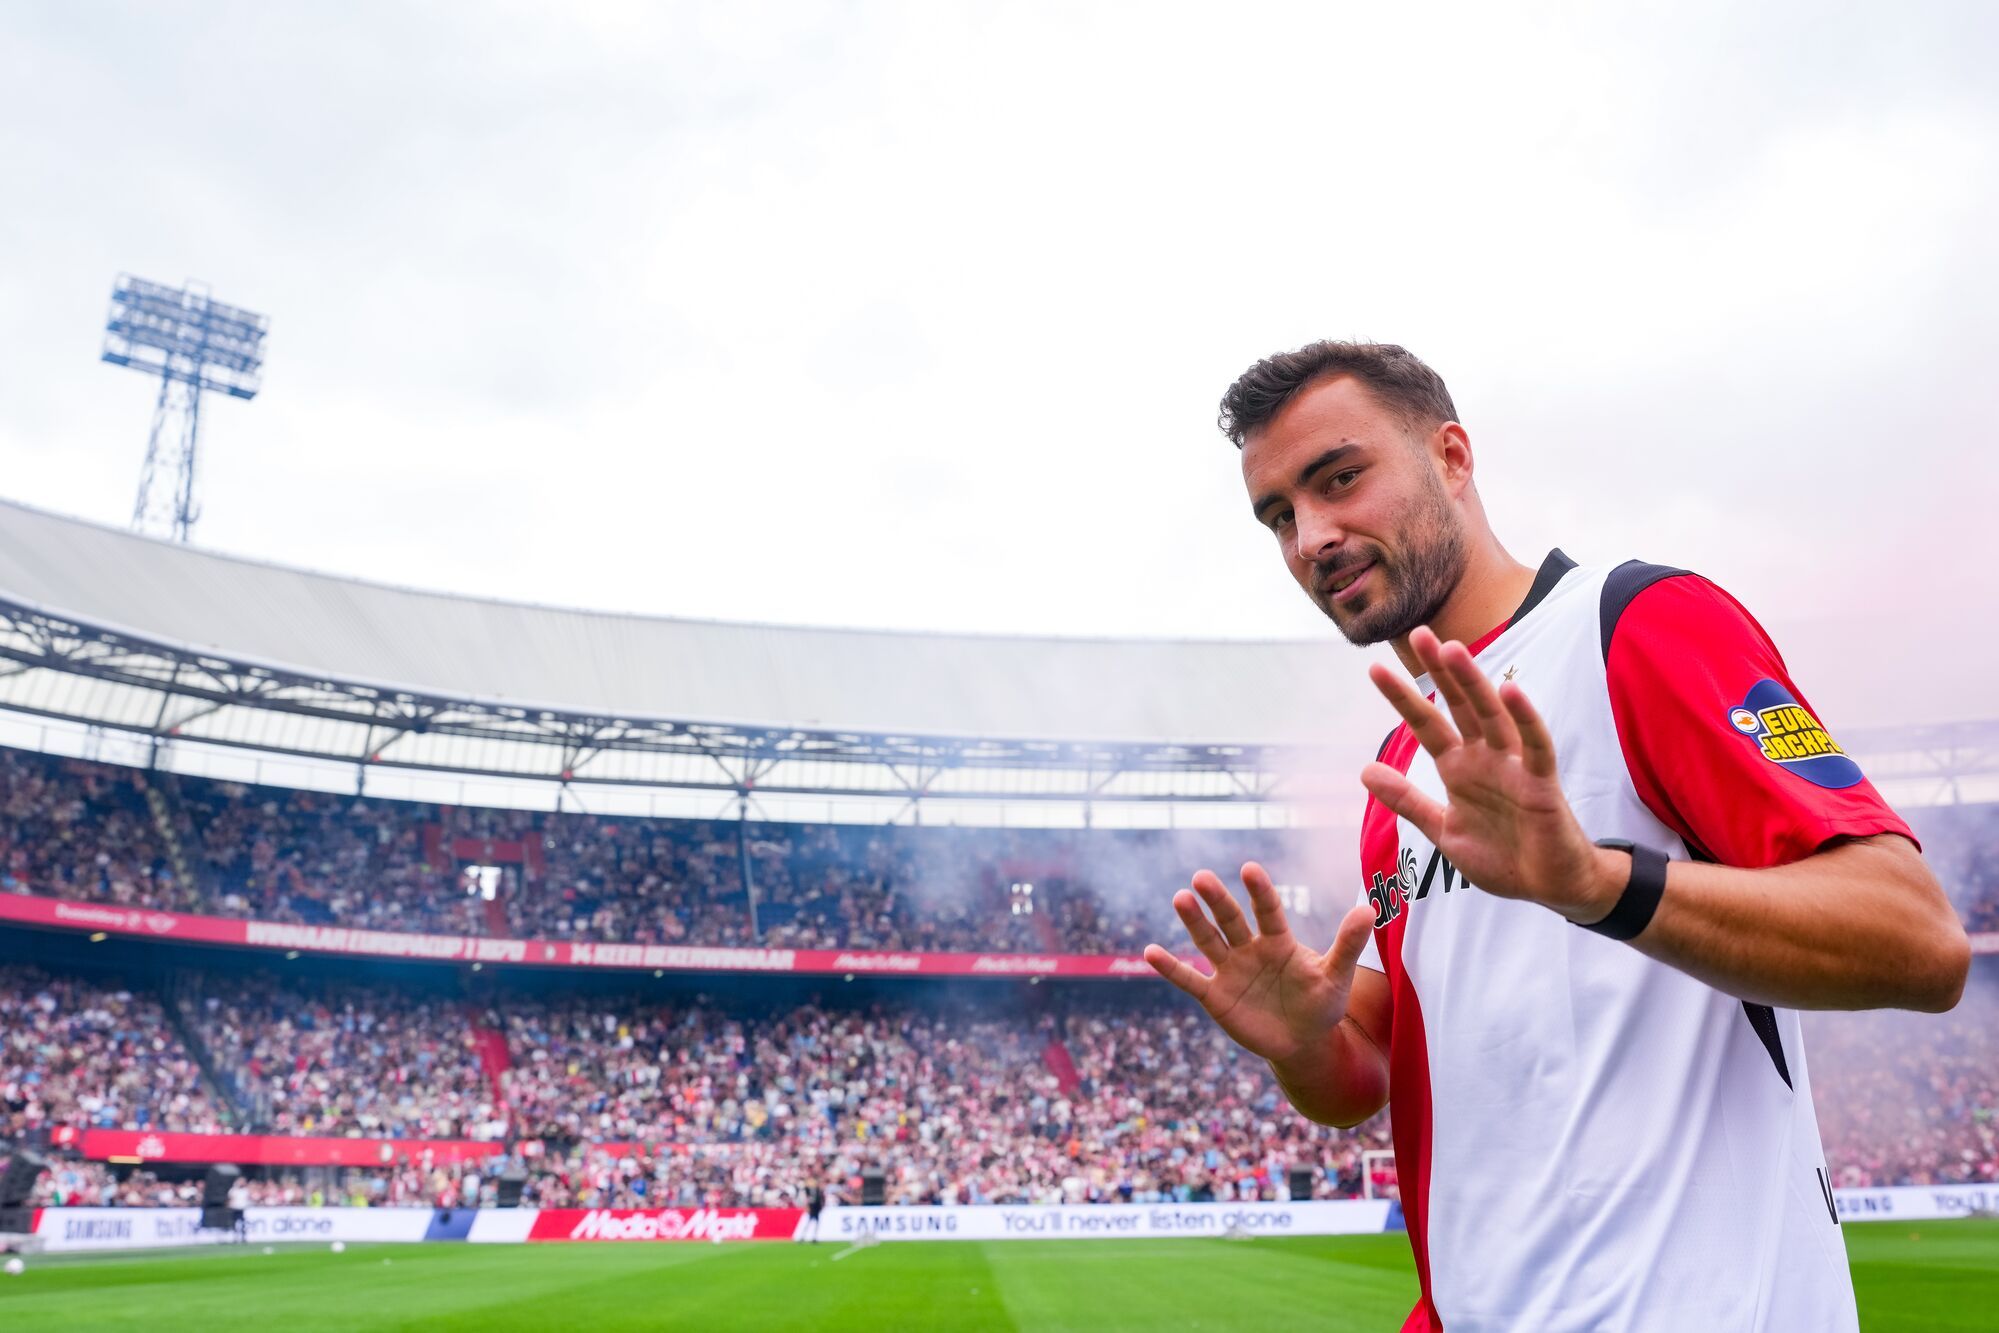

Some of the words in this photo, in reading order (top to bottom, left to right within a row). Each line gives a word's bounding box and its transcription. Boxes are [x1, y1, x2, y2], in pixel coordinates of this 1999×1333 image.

[1368, 871, 1401, 928] dia
[1836, 1193, 1894, 1214] SUNG
[63, 1217, 133, 1241] SAMSUNG
[841, 1215, 958, 1233] SAMSUNG
[1003, 1210, 1062, 1231] You'll
[1068, 1212, 1142, 1230] never
[1150, 1208, 1216, 1229] listen
[1222, 1208, 1293, 1229] alone
